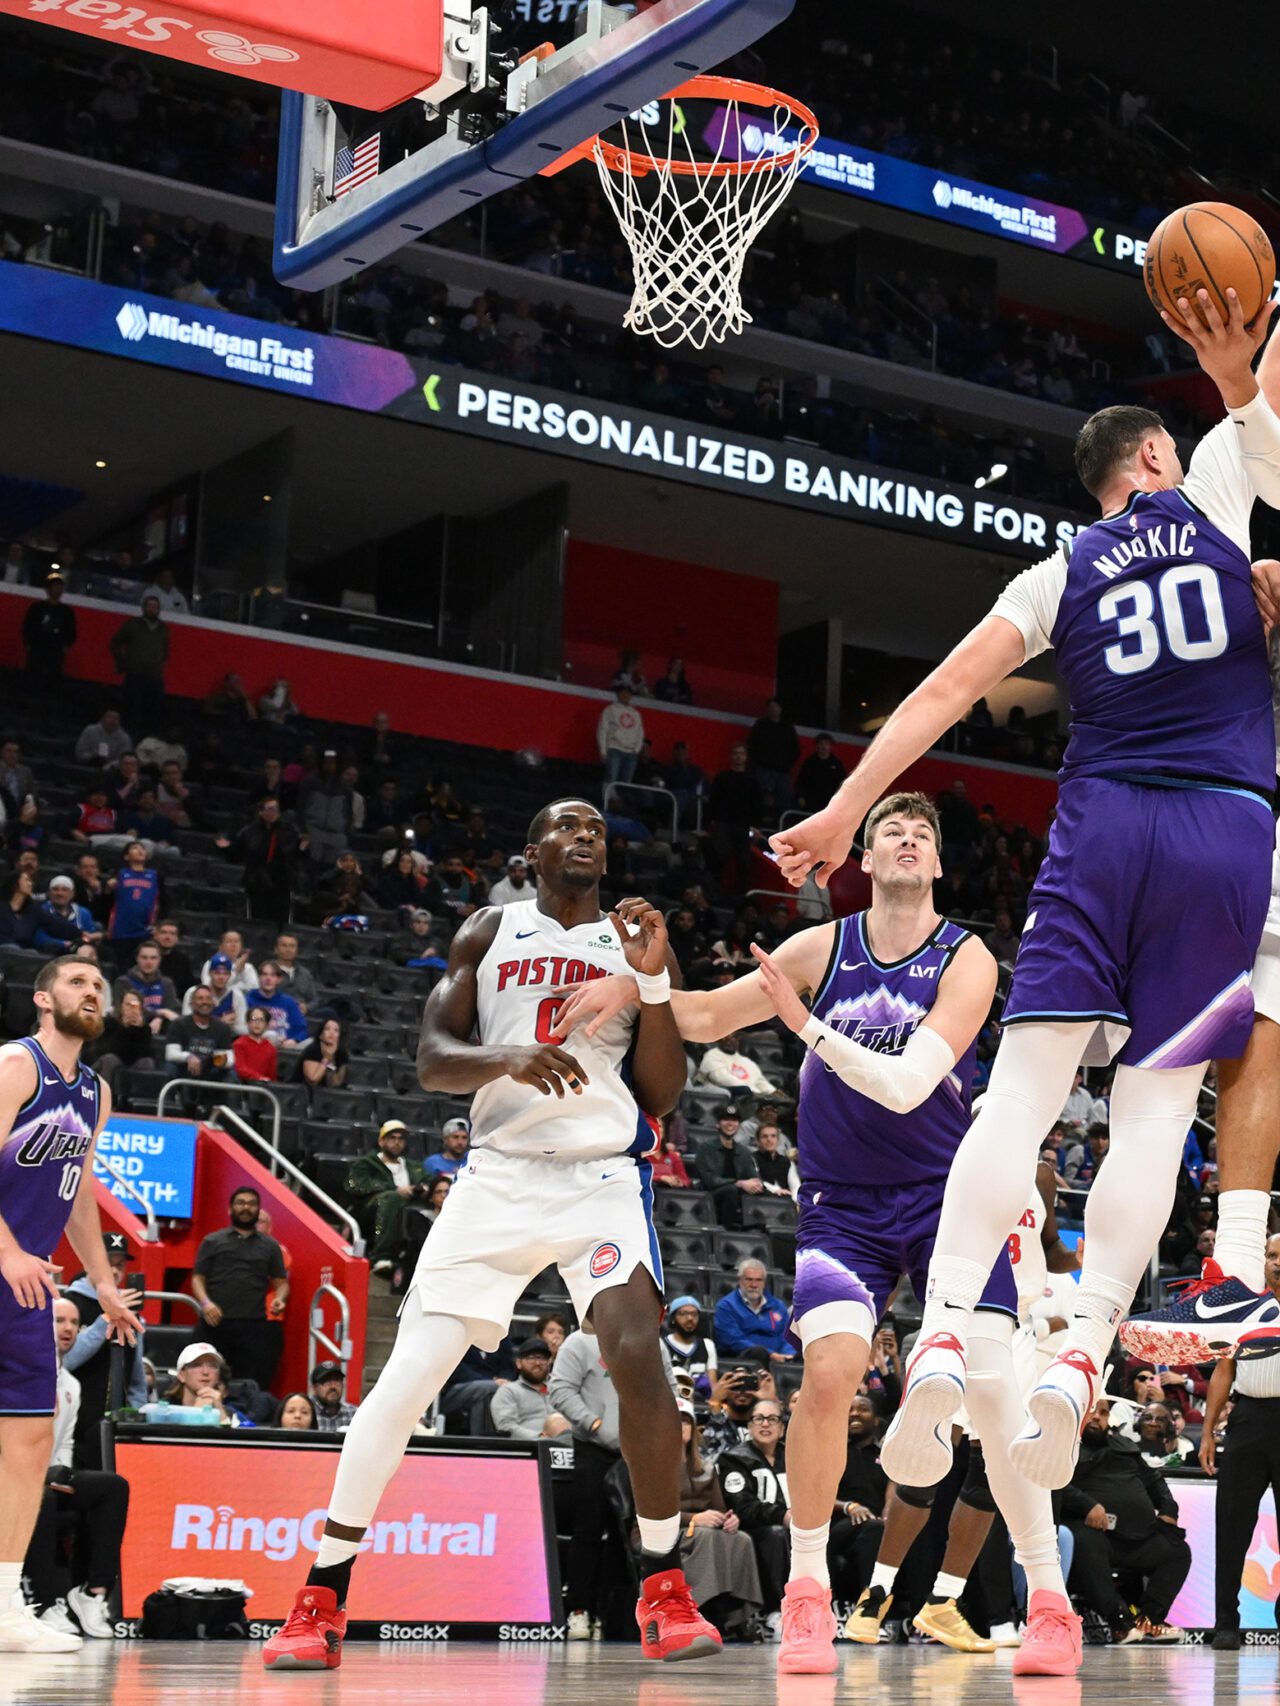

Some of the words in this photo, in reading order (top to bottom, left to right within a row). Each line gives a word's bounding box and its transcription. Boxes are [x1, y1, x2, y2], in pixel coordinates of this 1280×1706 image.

[763, 131, 838, 170] Michgan
[837, 152, 875, 180] First
[952, 187, 1020, 221] Michigan
[1021, 207, 1056, 232] First
[149, 312, 258, 358] Michigan
[260, 337, 315, 371] First
[226, 354, 272, 377] CREDIT
[273, 365, 314, 386] UNION
[457, 382, 775, 484] PERSONALIZED
[784, 459, 965, 528] BANKING
[974, 501, 1048, 548] FOR
[1098, 563, 1230, 676] 30
[587, 940, 621, 952] StockX
[497, 956, 615, 993] PISTON
[908, 963, 938, 979] LVT
[96, 1130, 165, 1156] ENRY
[58, 1161, 83, 1202] 10
[92, 1154, 144, 1177] ORD
[379, 1623, 449, 1640] StockX
[498, 1624, 566, 1641] StockX
[1245, 1631, 1279, 1646] Stoc
